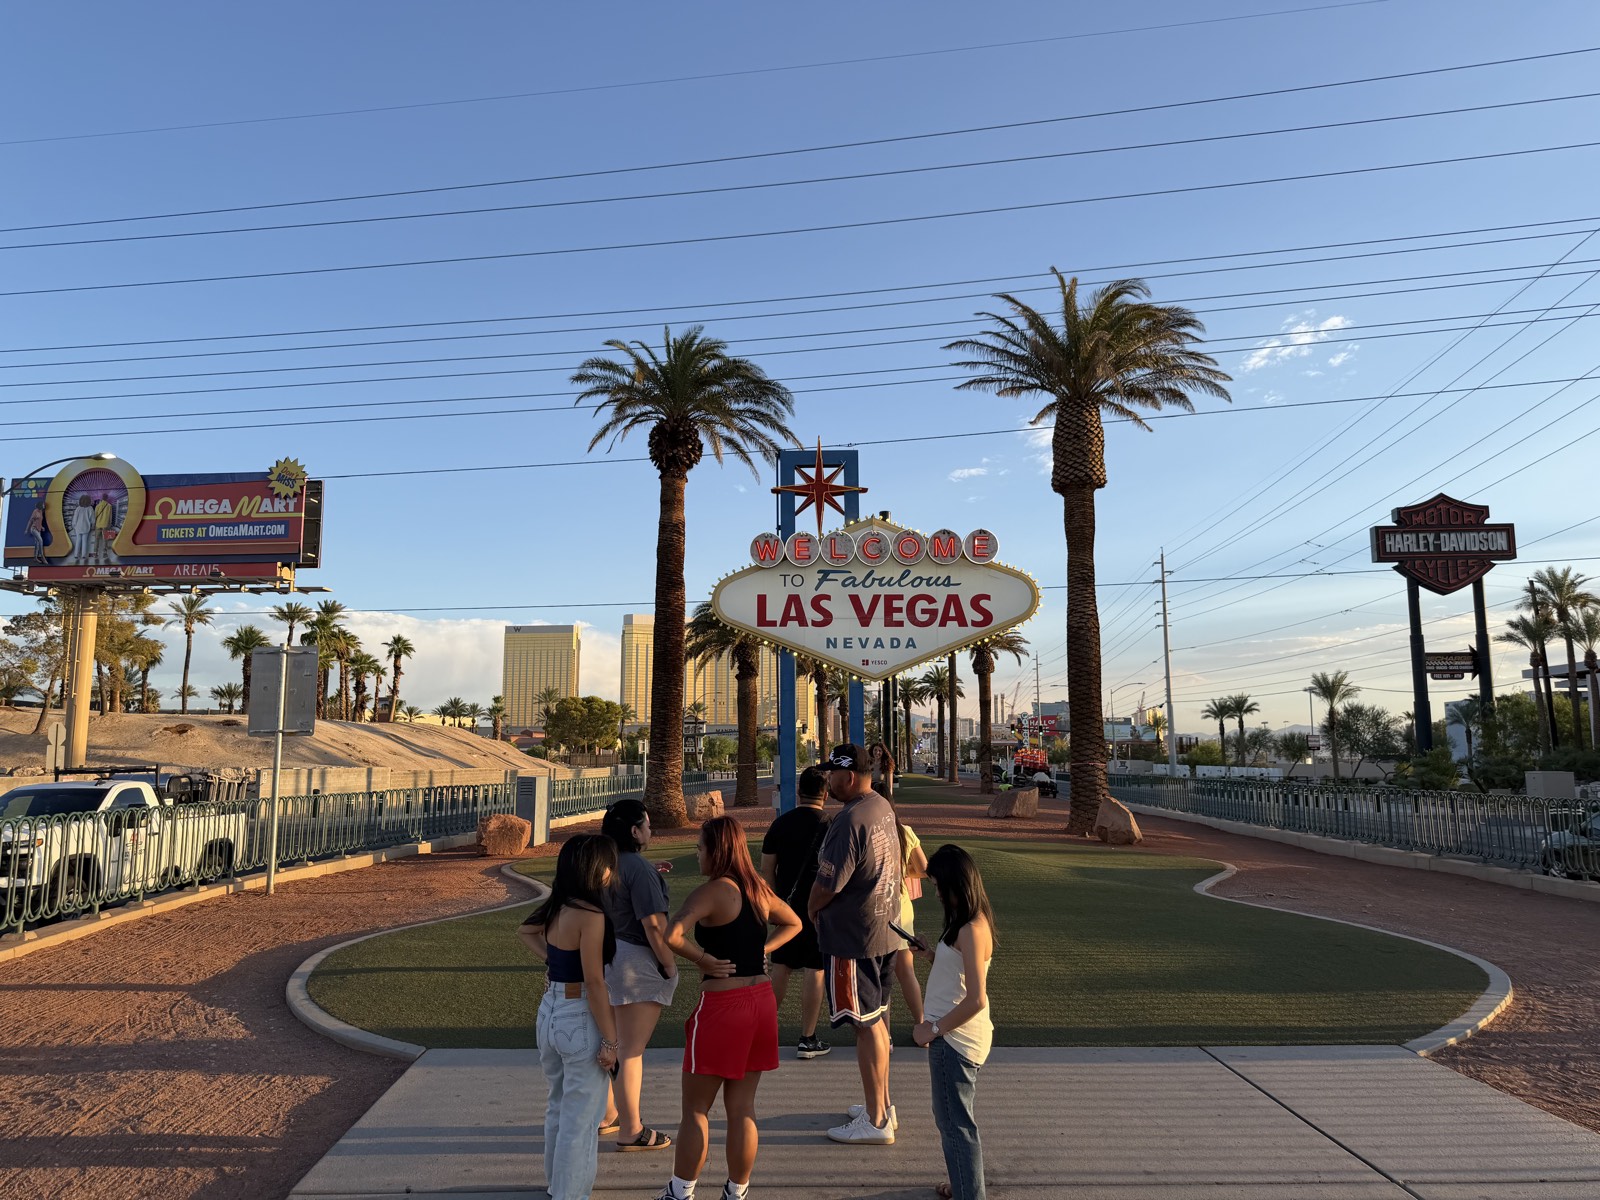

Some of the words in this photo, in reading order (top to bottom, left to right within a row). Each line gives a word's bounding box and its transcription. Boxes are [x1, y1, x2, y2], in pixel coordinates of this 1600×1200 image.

[276, 473, 297, 489] MISS
[281, 466, 300, 479] Don't
[235, 495, 298, 517] MART
[1412, 502, 1477, 525] MOTOR
[162, 527, 195, 539] TICKETS
[196, 527, 207, 538] AT
[1385, 531, 1508, 552] HARLEY-DAVIDSON
[755, 535, 990, 561] WELCOME
[779, 574, 804, 587] TO
[815, 569, 962, 591] Fabulous
[1415, 560, 1480, 584] CYCLES
[756, 594, 833, 627] LAS
[848, 594, 994, 627] VEGAS
[826, 637, 917, 649] NEVADA
